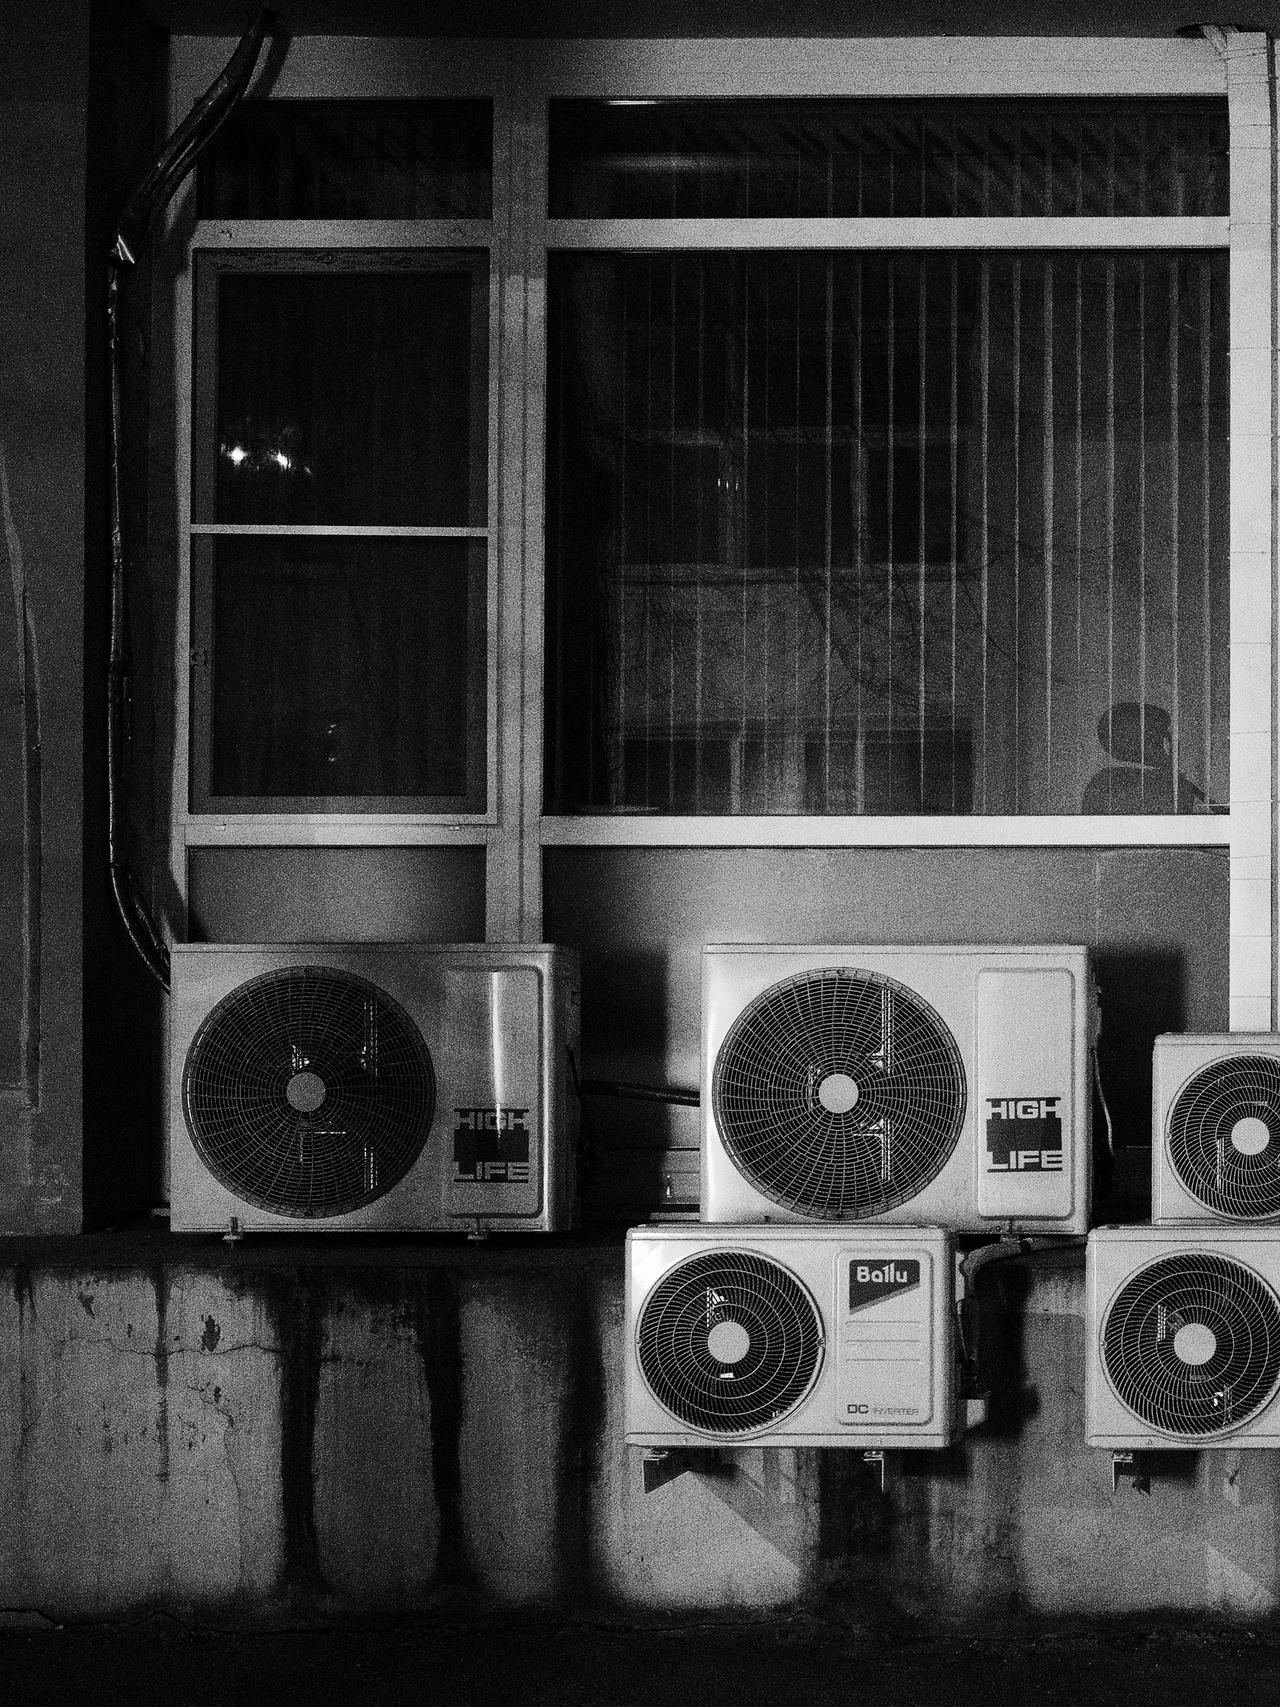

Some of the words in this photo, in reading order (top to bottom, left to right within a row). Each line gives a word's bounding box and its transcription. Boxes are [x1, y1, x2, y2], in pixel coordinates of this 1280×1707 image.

[986, 1100, 1061, 1119] HIGH
[454, 1111, 529, 1130] HIGH
[986, 1151, 1063, 1170] LIFE
[453, 1161, 529, 1181] LIFE
[857, 1262, 908, 1283] Ballu
[847, 1404, 869, 1414] DC
